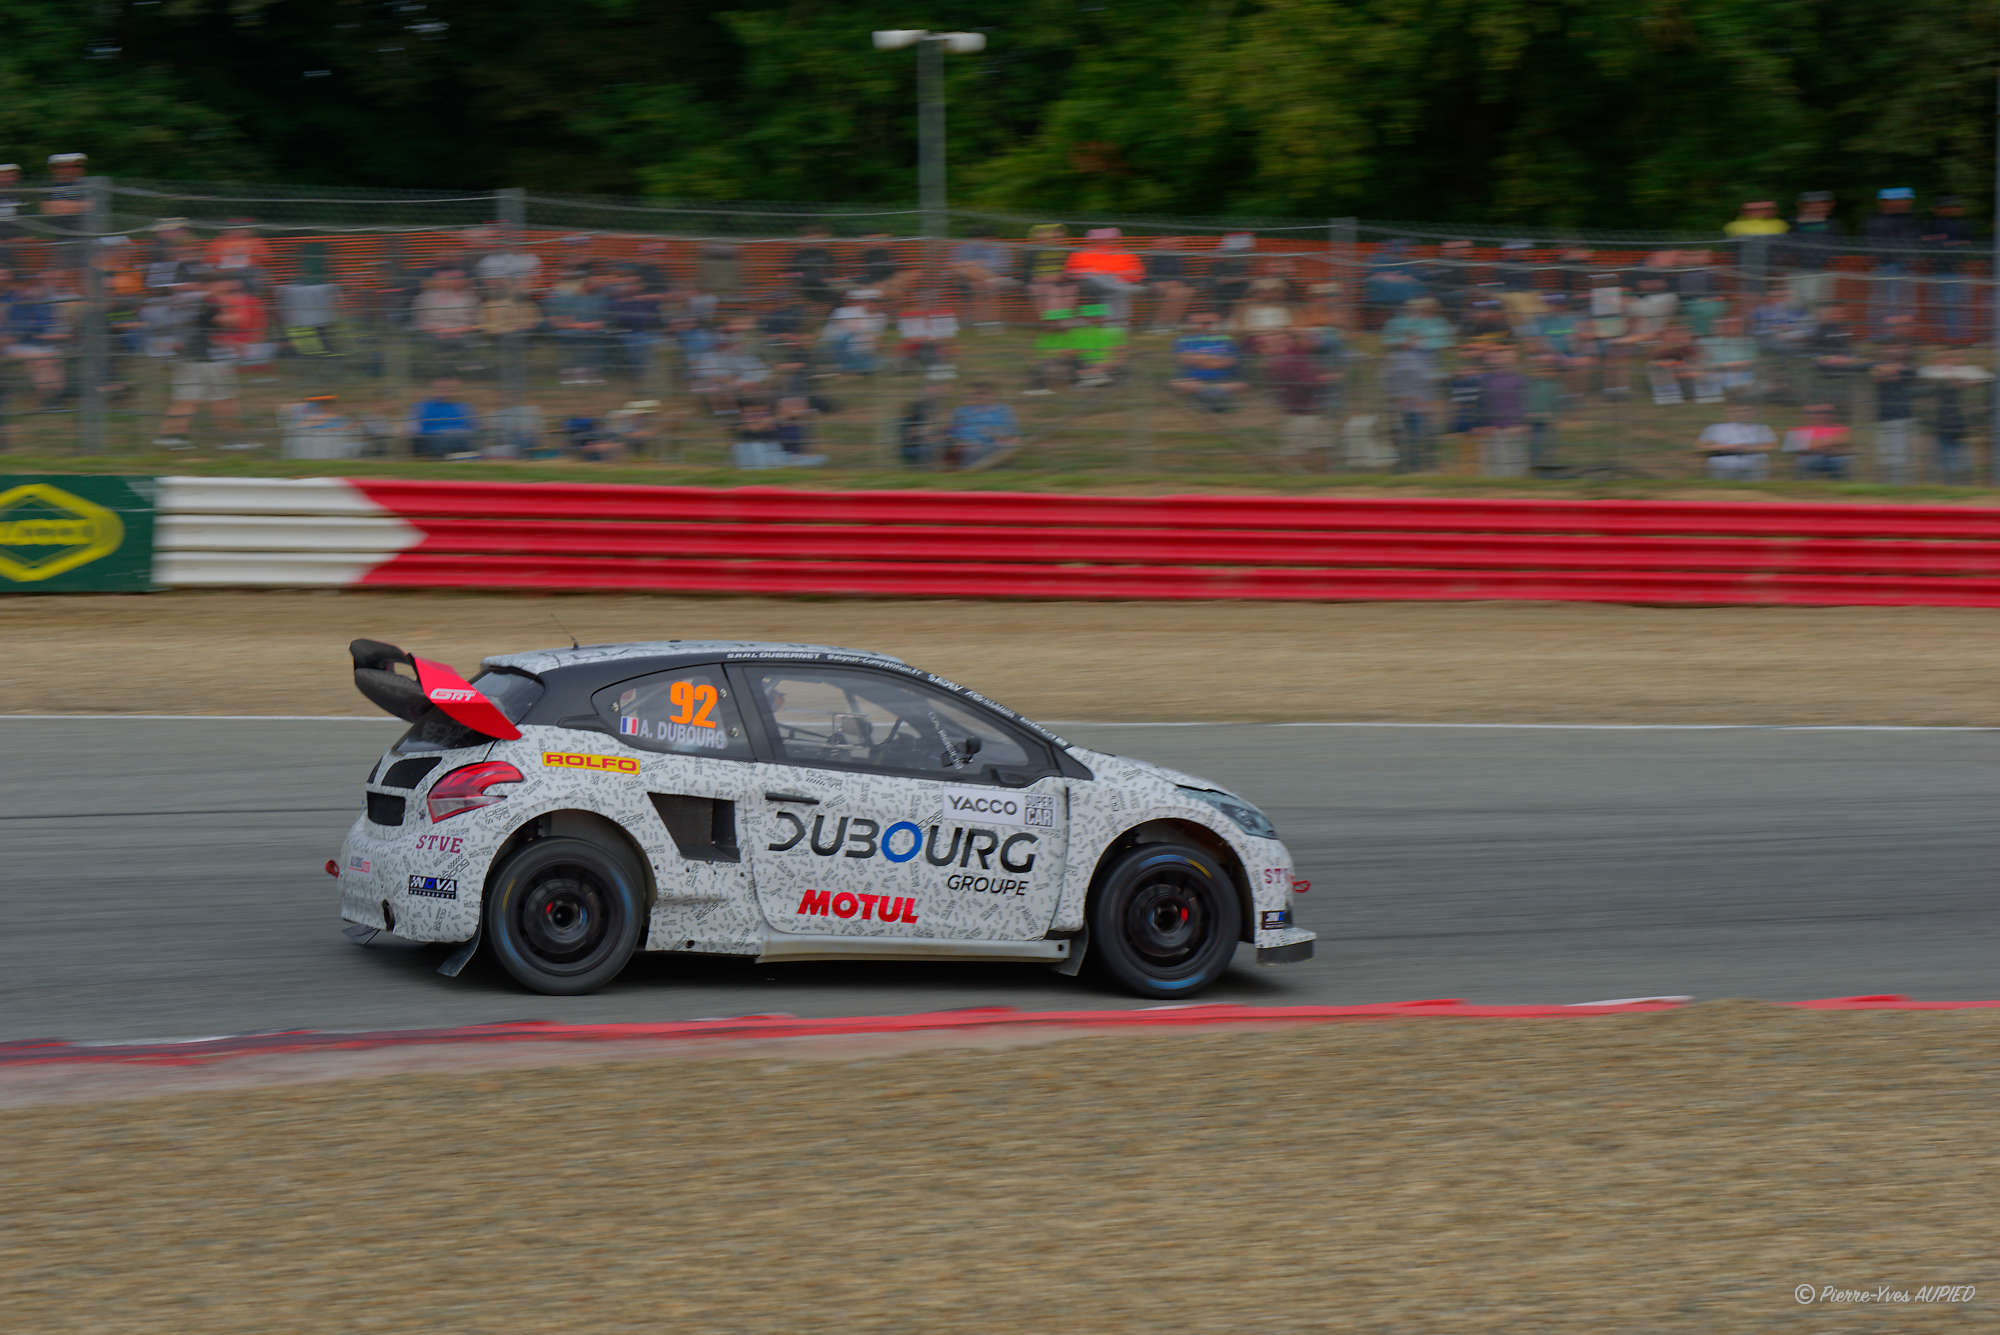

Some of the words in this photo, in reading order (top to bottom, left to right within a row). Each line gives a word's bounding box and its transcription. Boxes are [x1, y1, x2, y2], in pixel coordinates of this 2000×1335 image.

[669, 681, 718, 728] 92
[640, 720, 653, 738] A.
[657, 721, 728, 749] DUBOURG
[546, 755, 637, 771] ROLFO
[948, 795, 1017, 815] YACCO
[1025, 808, 1053, 826] CAR
[416, 835, 463, 853] STVE
[768, 811, 1040, 873] DUBOURG
[947, 874, 1029, 895] GROUPE
[797, 889, 918, 924] MOTUL
